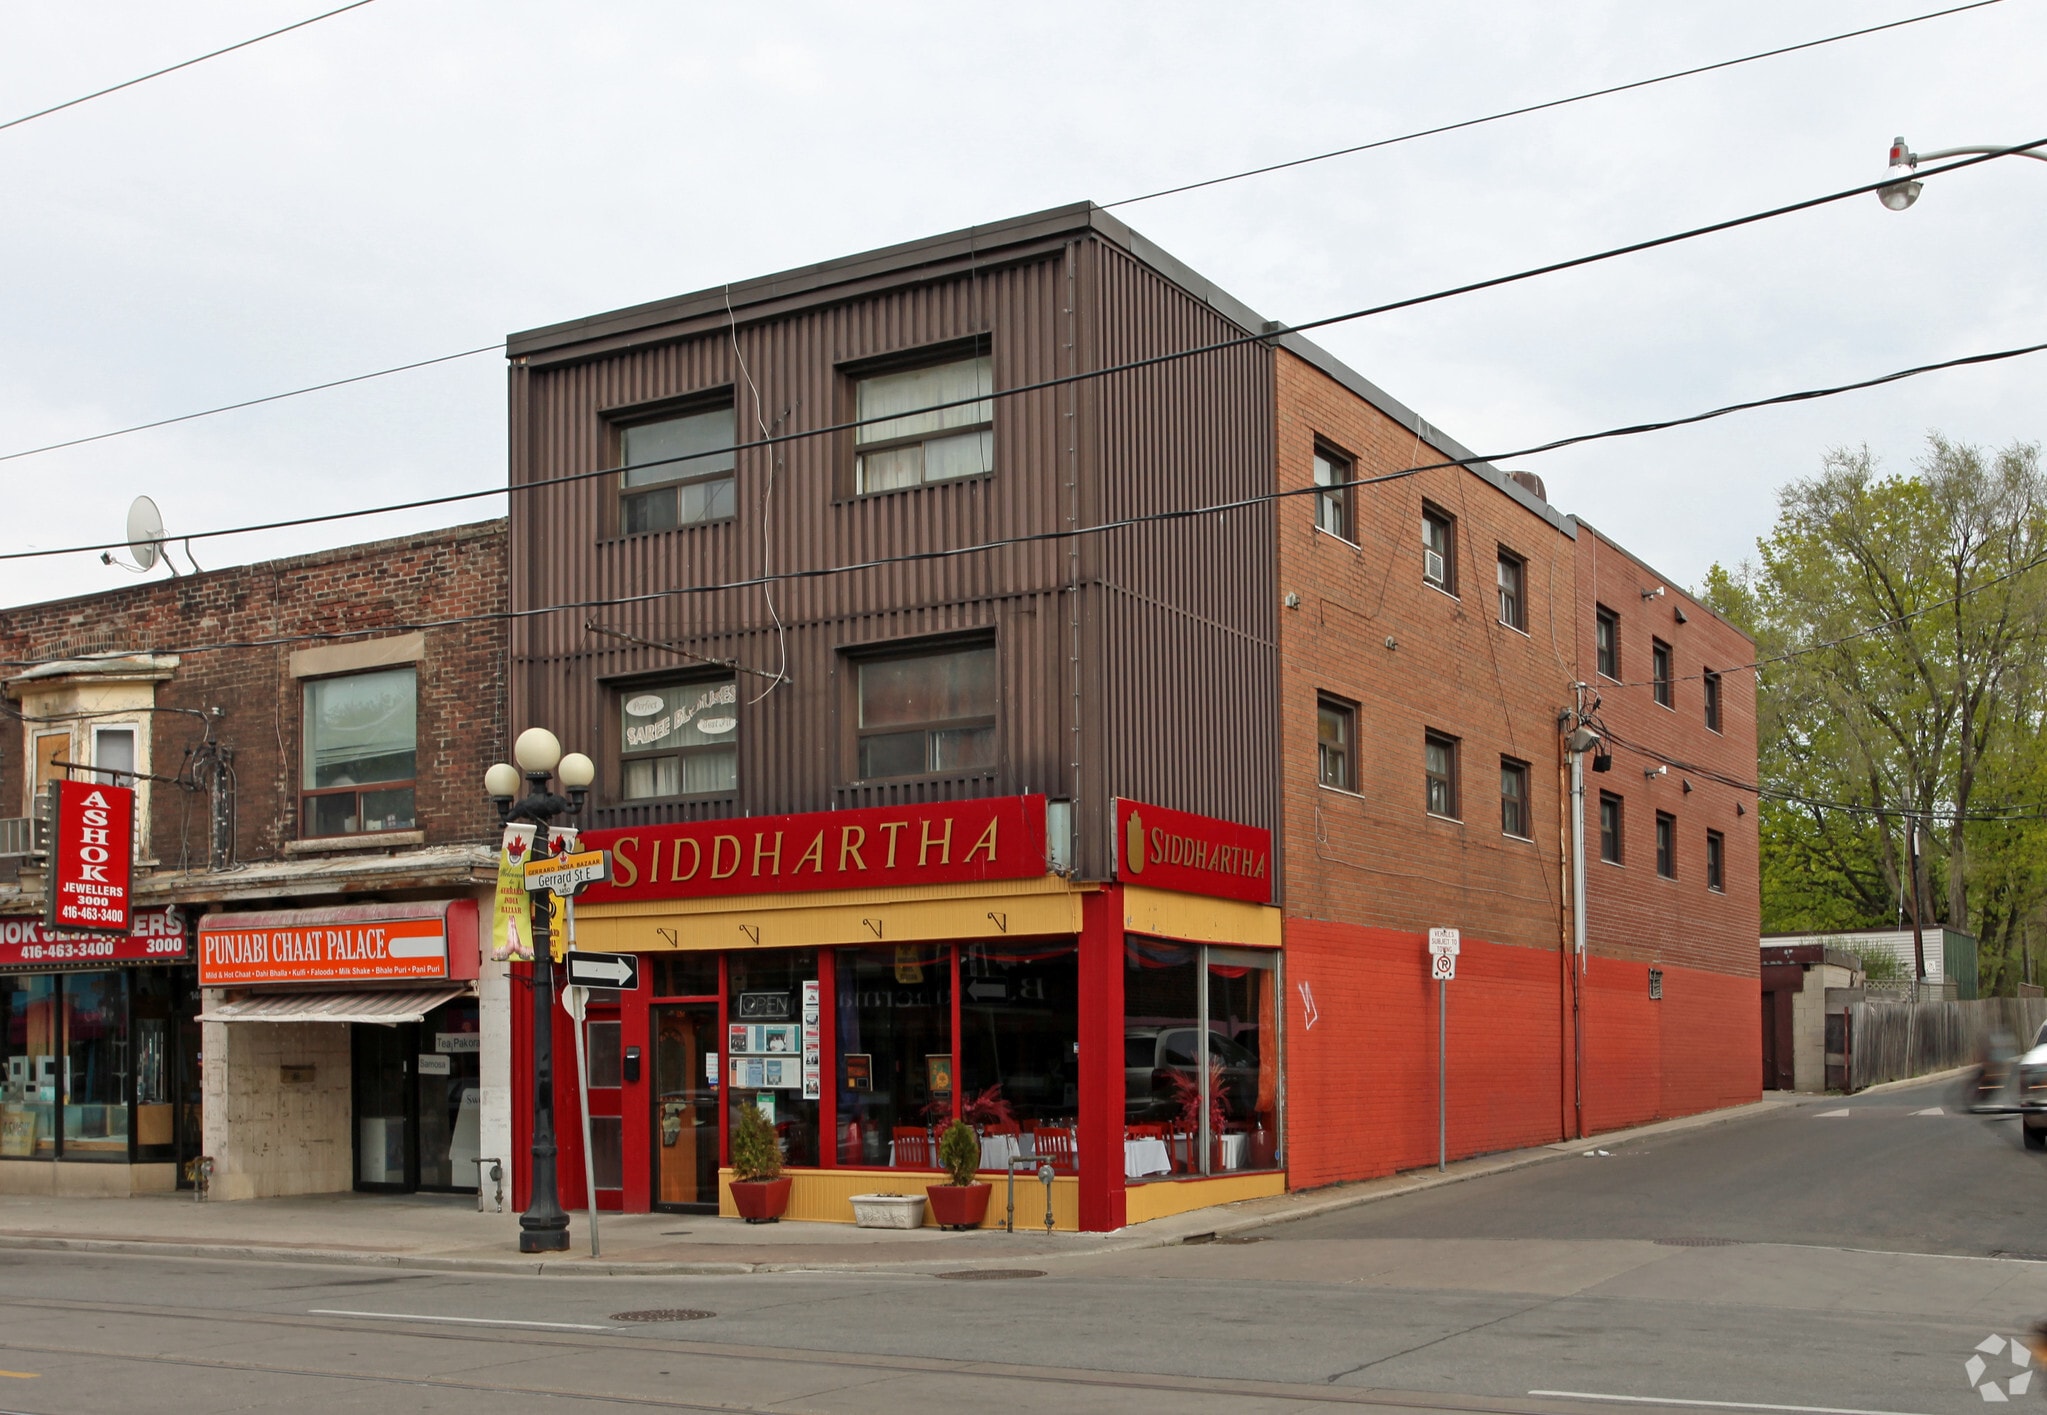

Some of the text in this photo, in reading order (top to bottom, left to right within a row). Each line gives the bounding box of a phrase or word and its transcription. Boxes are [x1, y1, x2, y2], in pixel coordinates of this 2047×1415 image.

[626, 716, 671, 746] SAREE
[78, 790, 112, 883] ASHOK
[1150, 826, 1265, 879] SIDDHARTHA
[528, 859, 600, 876] GERRARD INDIA BAZAAR
[538, 867, 591, 887] Gerrard St E
[63, 882, 124, 897] JEWELLERS
[77, 895, 109, 906] 3000
[62, 905, 123, 923] 416-463-3400
[501, 906, 522, 914] BAZAAR
[0, 921, 38, 944] OK
[21, 941, 114, 959] 416-463-3400
[146, 937, 182, 953] 3000
[204, 928, 387, 965] PUNJABI CHAAT PALACE
[224, 970, 234, 978] Hot
[235, 970, 251, 978] Chaat
[255, 969, 269, 977] Dahi
[269, 969, 288, 977] Bhalla
[292, 968, 306, 976] Kulfi
[310, 968, 334, 976] Falooda
[339, 967, 351, 975] Milk
[352, 967, 371, 975] Shake
[394, 965, 407, 974] Puri
[412, 965, 426, 973] Pani
[427, 965, 440, 973] Puri
[743, 996, 788, 1013] OPEN
[437, 1038, 451, 1048] Tea
[420, 1058, 446, 1069] Samosa
